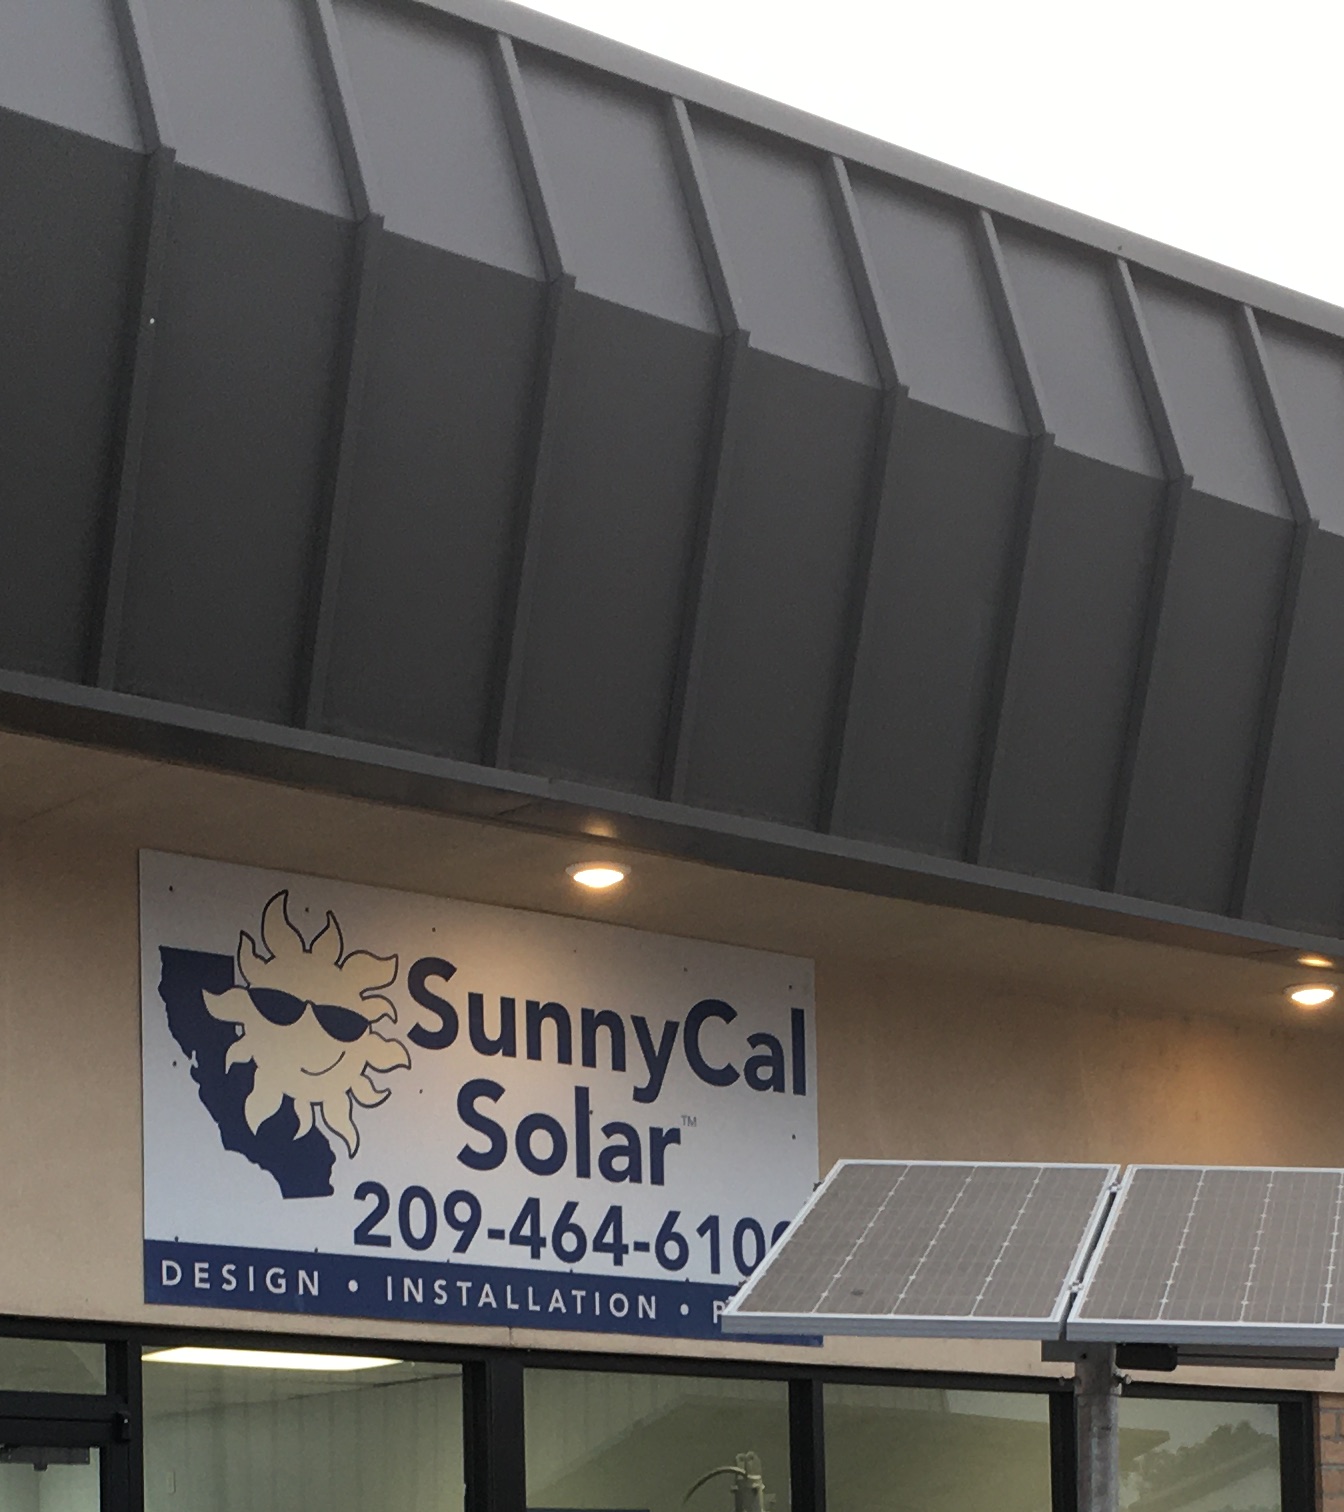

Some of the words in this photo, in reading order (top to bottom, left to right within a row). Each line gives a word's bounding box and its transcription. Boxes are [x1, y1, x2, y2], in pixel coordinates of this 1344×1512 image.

[407, 956, 806, 1103] SunnyCal
[457, 1078, 681, 1186] Solar
[161, 1259, 319, 1296] DESIGN
[386, 1275, 657, 1320] INSTALLATION
